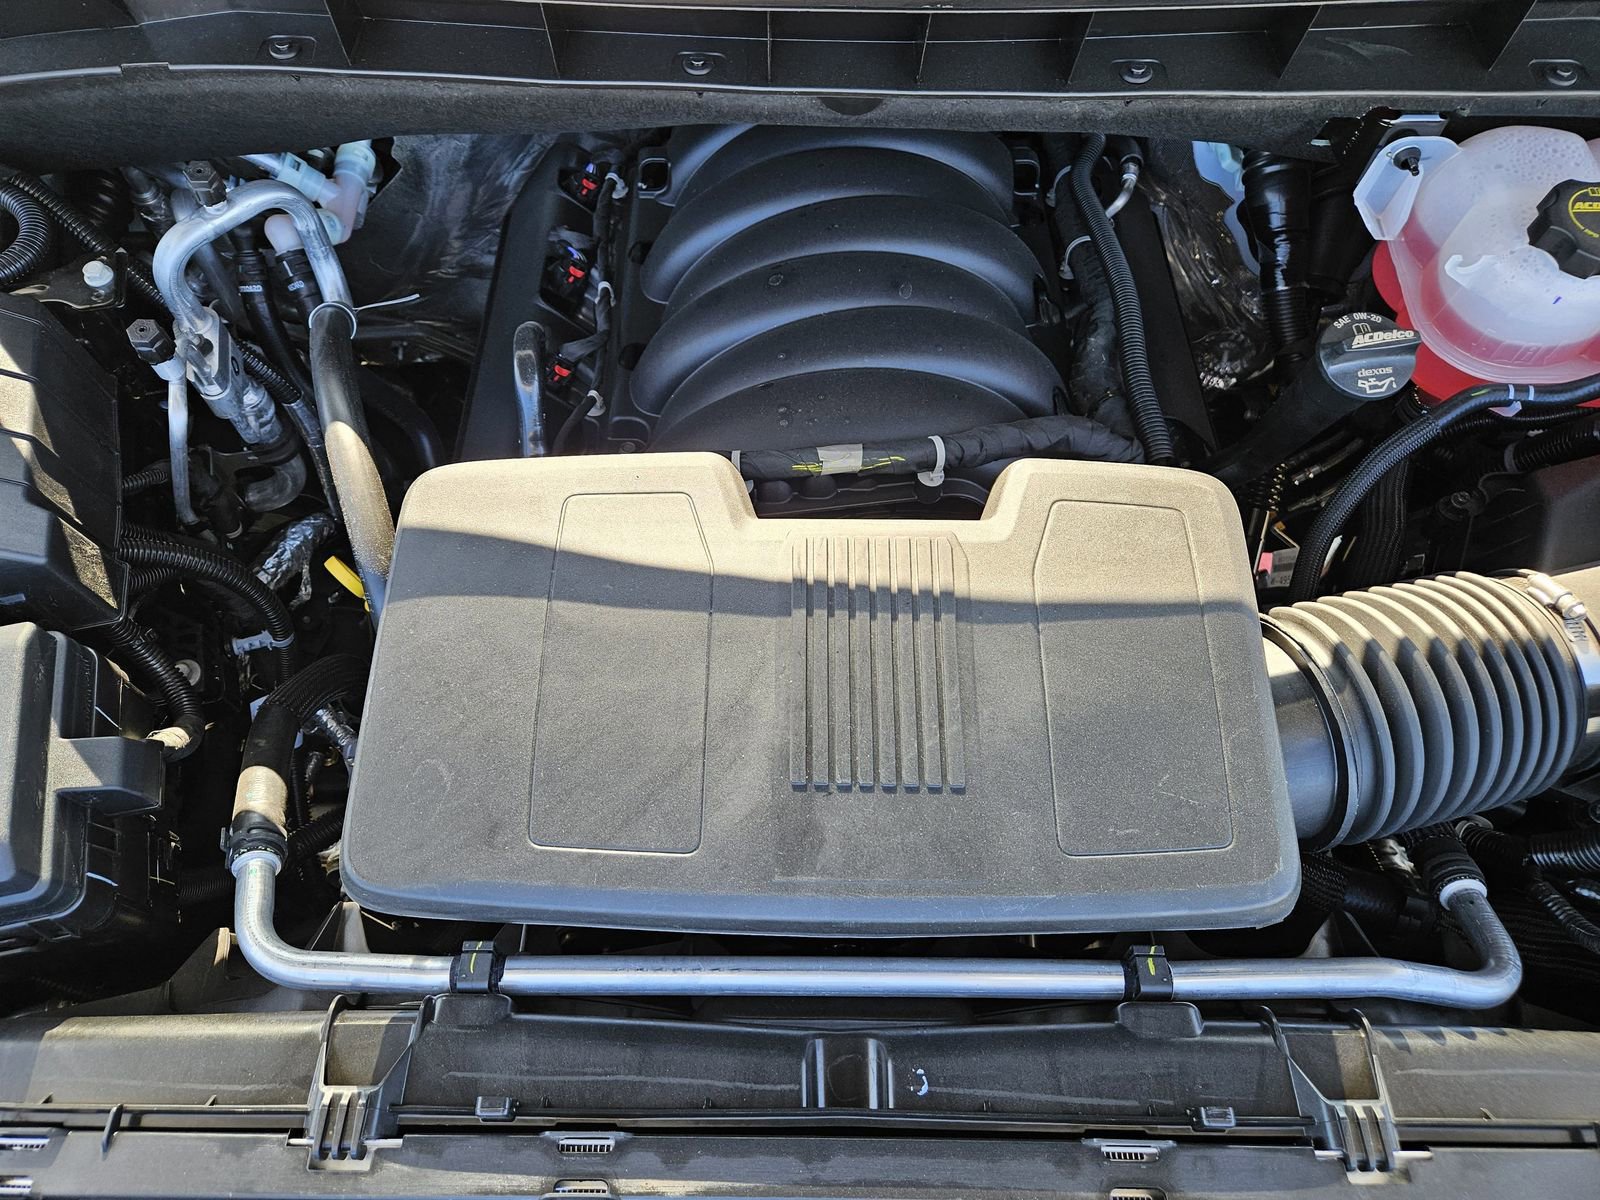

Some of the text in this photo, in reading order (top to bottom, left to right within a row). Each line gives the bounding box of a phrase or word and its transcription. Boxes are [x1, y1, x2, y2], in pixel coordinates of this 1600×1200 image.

[1333, 312, 1382, 329] SAE 0W-20
[1352, 329, 1415, 346] ACDelco
[1357, 366, 1393, 377] dexos
